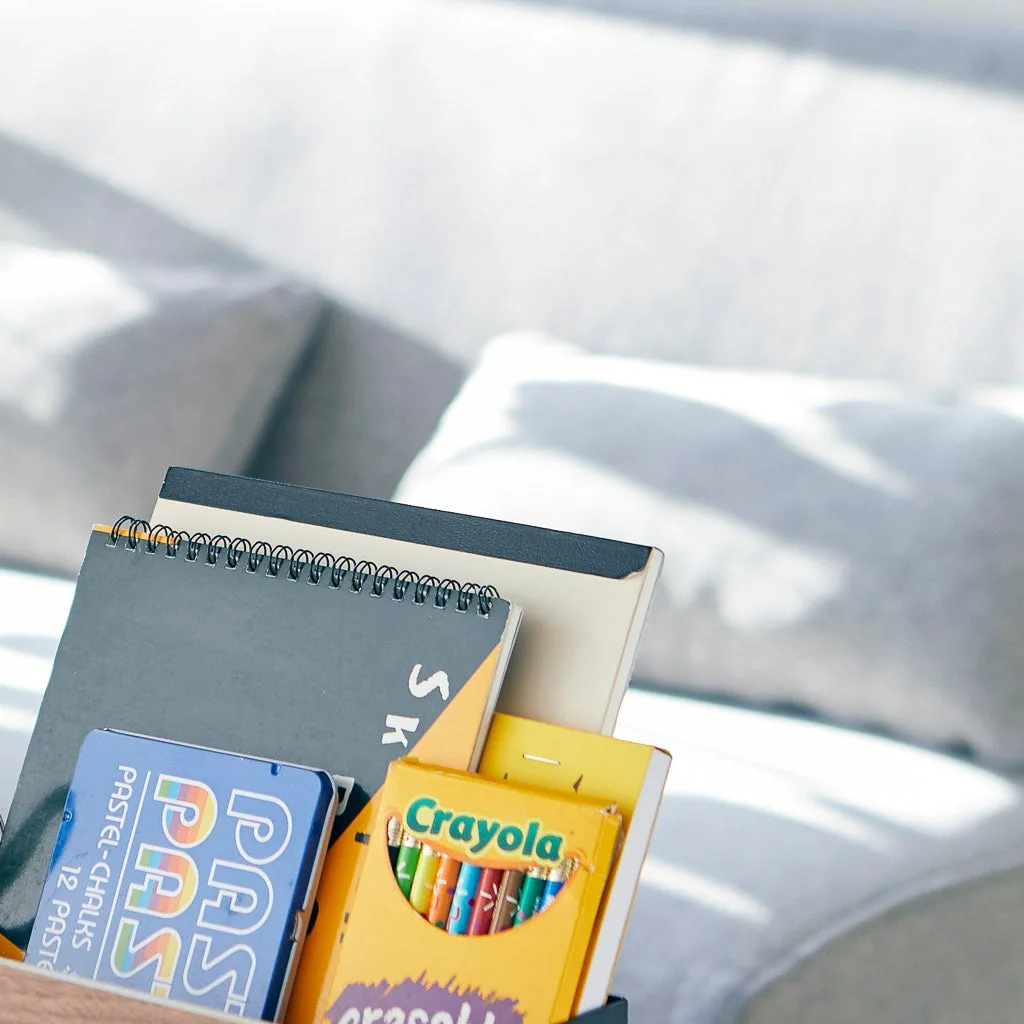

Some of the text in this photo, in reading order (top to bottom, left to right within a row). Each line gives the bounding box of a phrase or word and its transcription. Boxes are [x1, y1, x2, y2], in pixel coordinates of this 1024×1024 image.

[57, 866, 81, 891] 12
[72, 764, 137, 952] PASTEL-CHALKS
[110, 773, 218, 999] PAS
[182, 787, 293, 1017] PAS
[406, 797, 563, 862] Crayola
